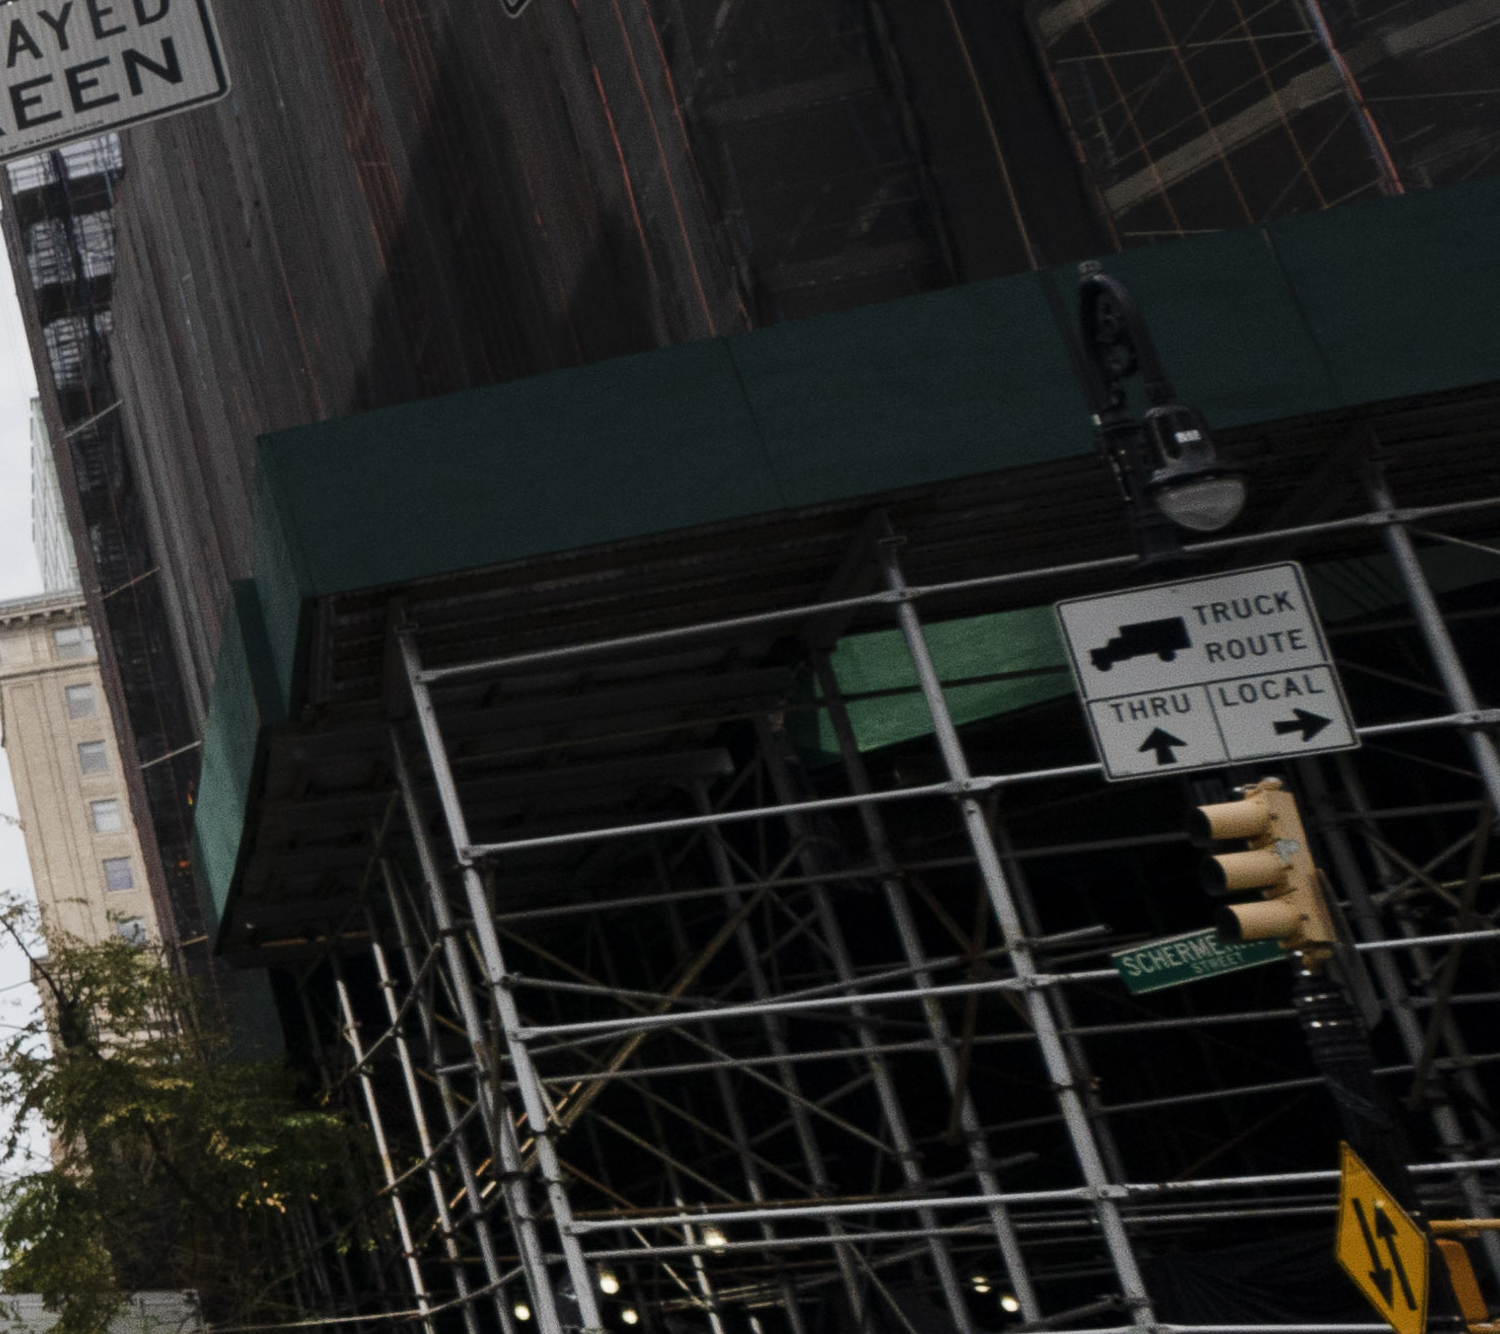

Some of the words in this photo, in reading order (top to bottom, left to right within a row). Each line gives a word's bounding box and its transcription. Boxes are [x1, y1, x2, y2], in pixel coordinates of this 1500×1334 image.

[1192, 591, 1295, 625] TRUCK
[1205, 628, 1307, 663] ROUTE
[1218, 674, 1325, 707] LOCAL
[1110, 693, 1191, 722] THRU
[1122, 934, 1262, 977] SCHERME
[1190, 951, 1245, 974] STREET
